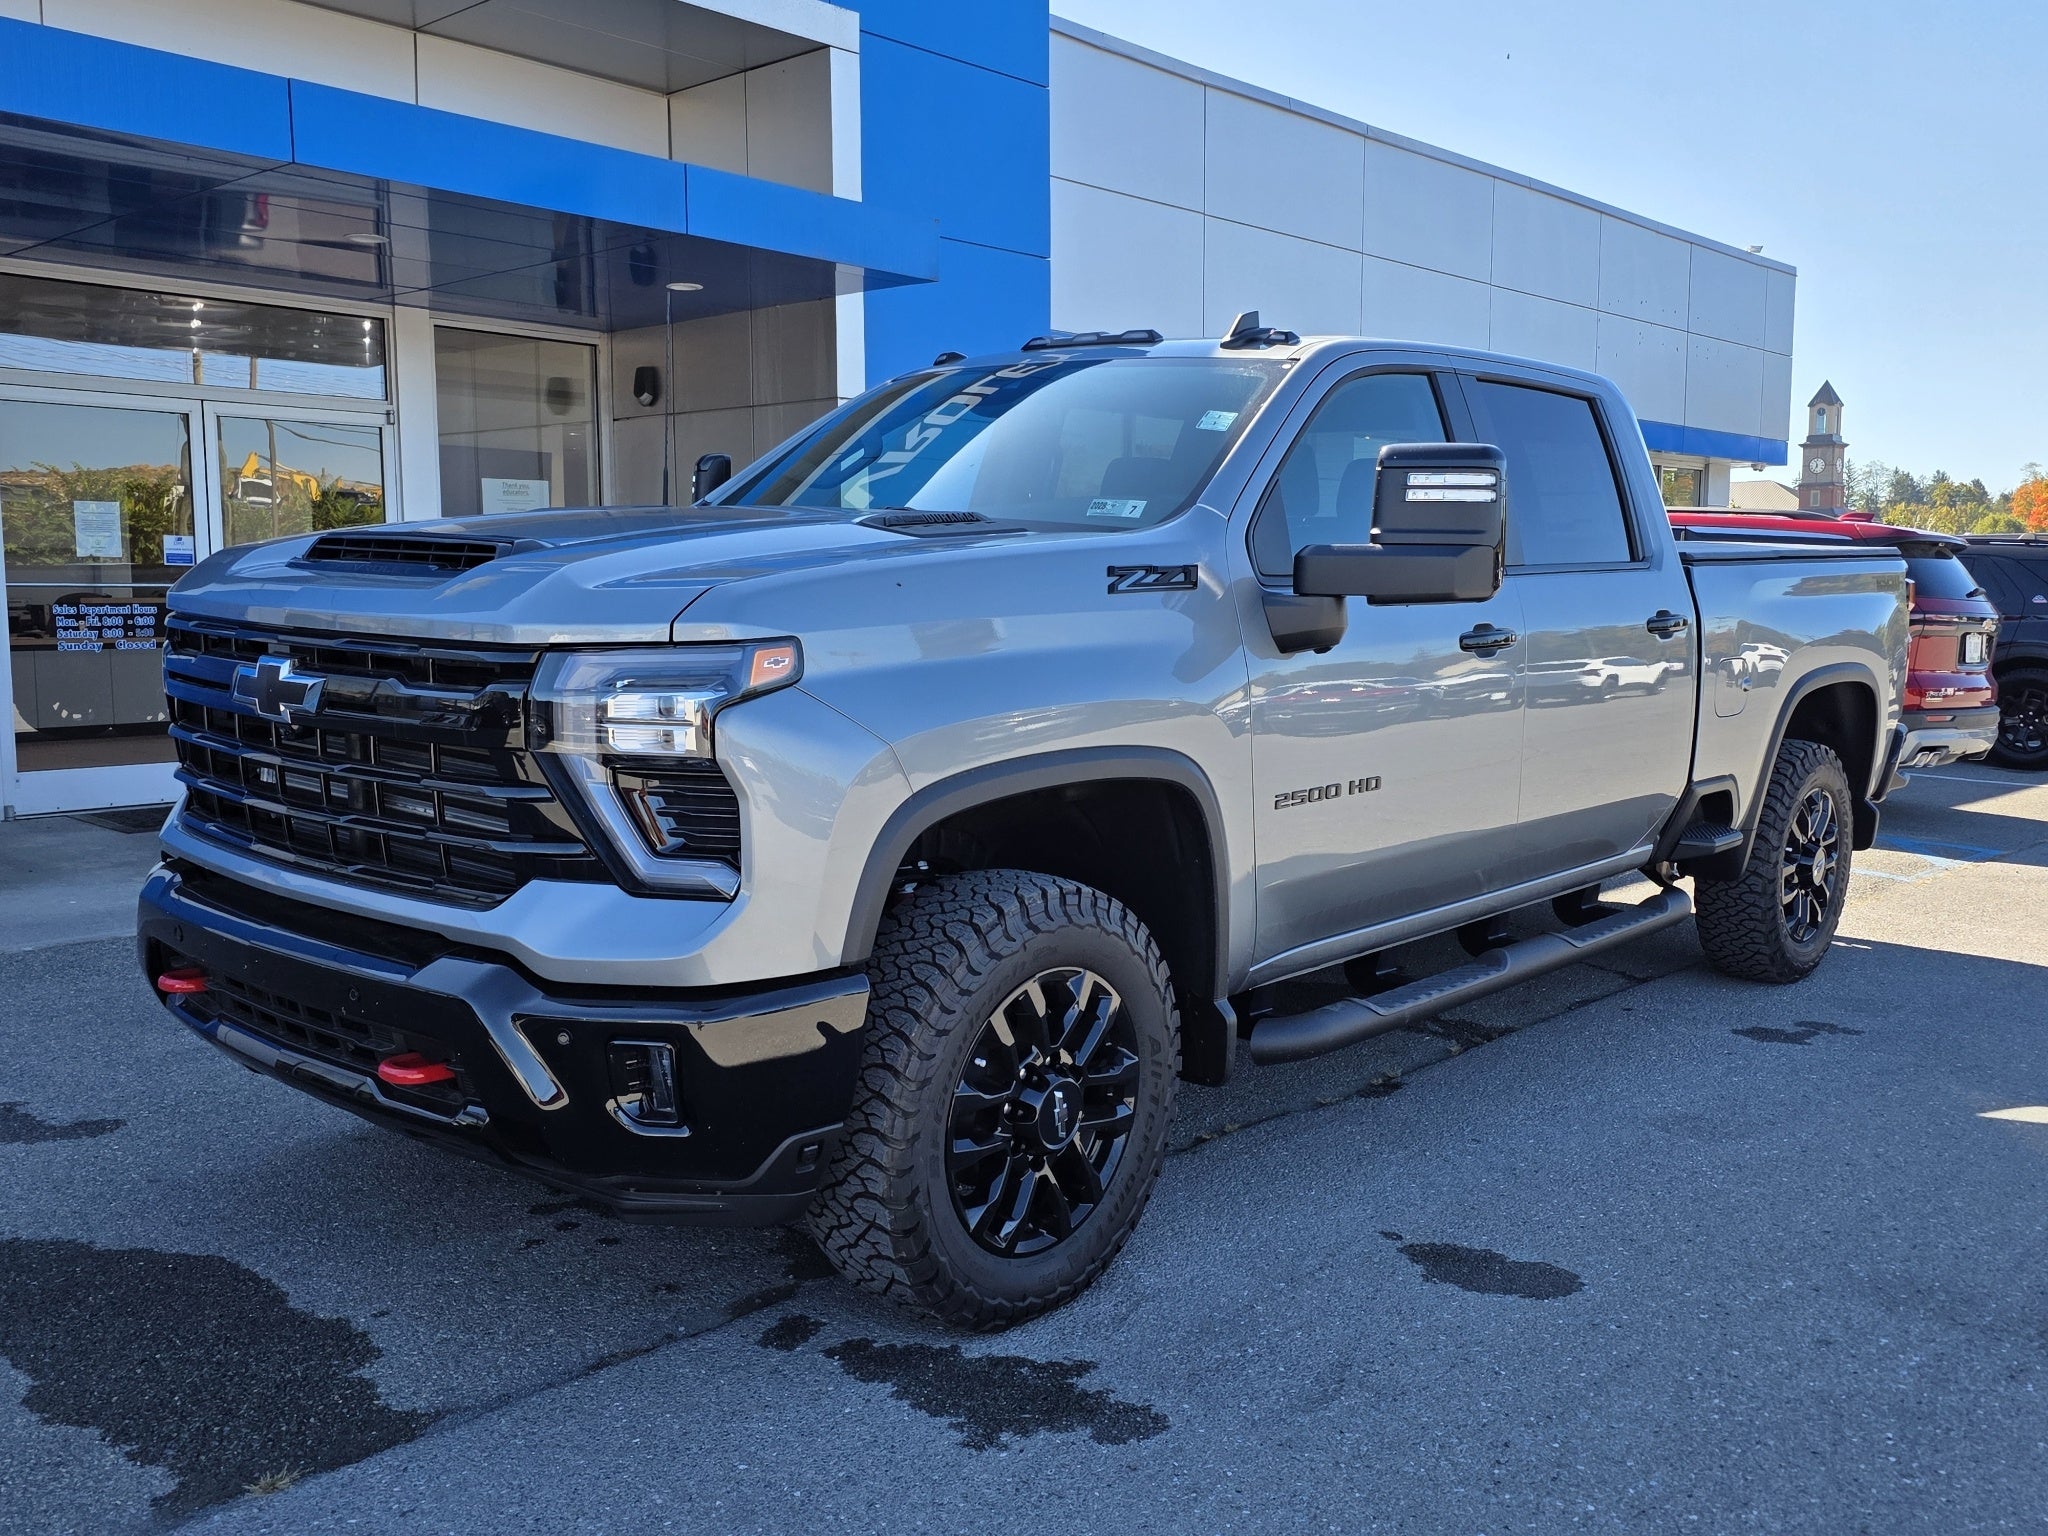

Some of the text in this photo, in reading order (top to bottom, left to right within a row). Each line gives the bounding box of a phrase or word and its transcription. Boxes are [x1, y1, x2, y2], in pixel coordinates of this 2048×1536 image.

[1128, 505, 1138, 515] 7
[1107, 564, 1199, 595] Z71
[52, 604, 158, 617] Sales Department Hours
[56, 616, 79, 627] Mon.
[85, 616, 102, 627] Fri.
[102, 616, 124, 627] 8:00
[134, 616, 156, 626] 6:00
[56, 629, 99, 641] Saturday
[102, 628, 124, 638] 8:00
[57, 639, 157, 653] Sunday Closed
[1274, 775, 1382, 810] 2500 HD
